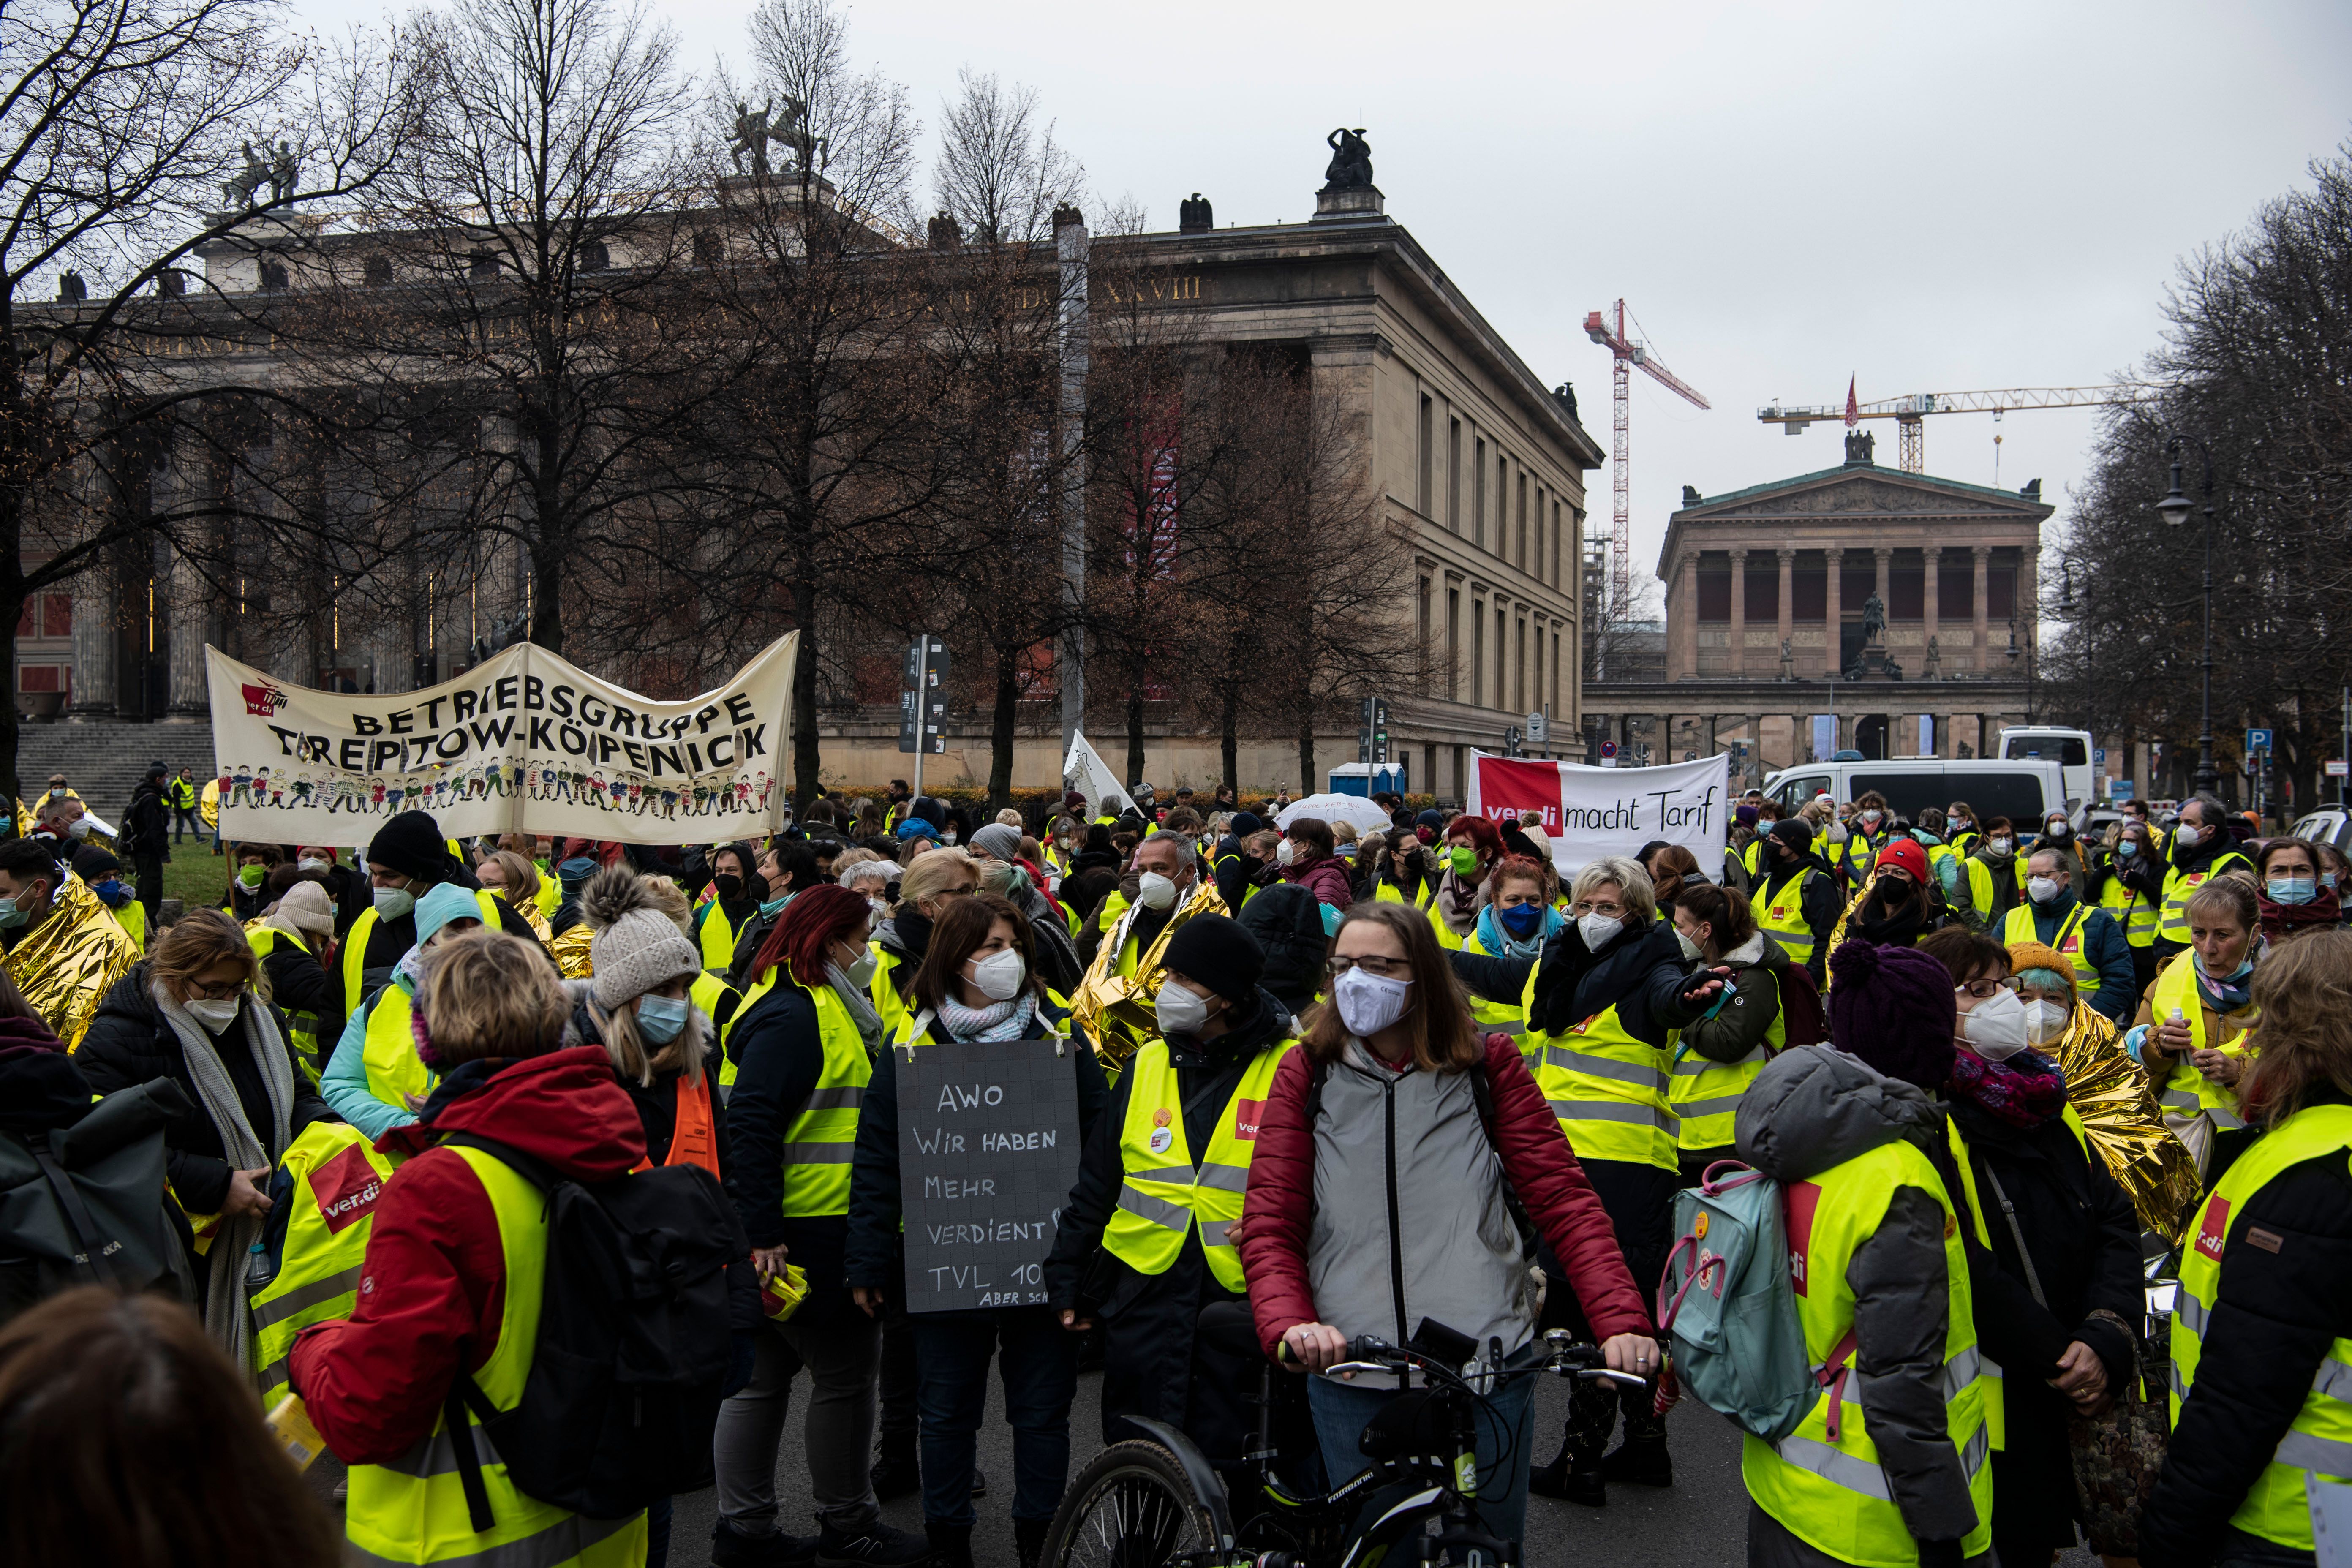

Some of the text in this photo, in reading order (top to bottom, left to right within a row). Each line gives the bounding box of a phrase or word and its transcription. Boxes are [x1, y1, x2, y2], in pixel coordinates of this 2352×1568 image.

[352, 675, 755, 742] BETRIEBSGRUPPE
[268, 715, 766, 782] TREPTOW-KÖPENICK
[2251, 732, 2265, 748] P
[1487, 785, 1718, 835] verdi macht Tarif
[937, 1084, 1003, 1112] AWO
[1239, 1122, 1259, 1133] ver
[983, 1130, 1056, 1152] HABEN
[325, 1181, 380, 1217] ver.di
[926, 1176, 995, 1199] MEHR
[2197, 1230, 2223, 1254] r.di
[928, 1263, 1041, 1292] TVL 10
[979, 1291, 1019, 1306] ABER
